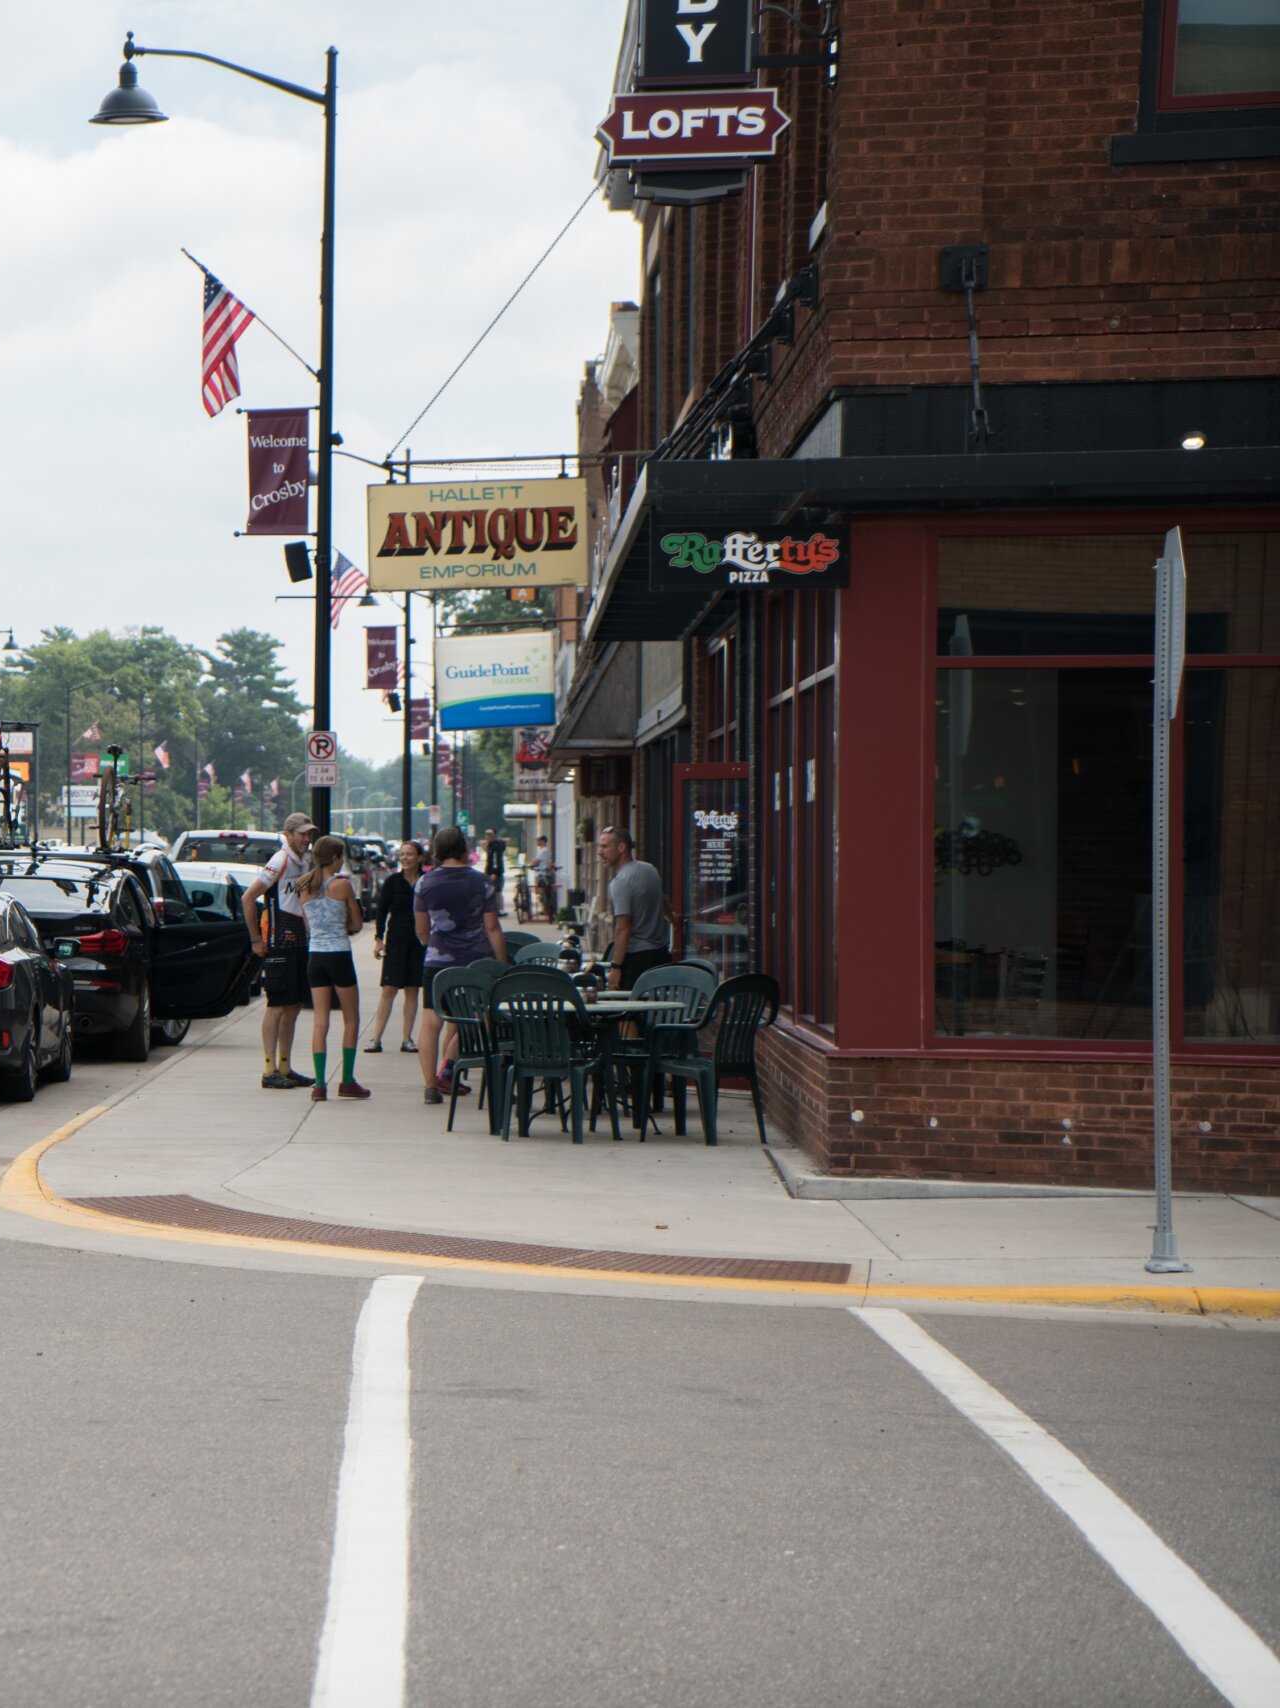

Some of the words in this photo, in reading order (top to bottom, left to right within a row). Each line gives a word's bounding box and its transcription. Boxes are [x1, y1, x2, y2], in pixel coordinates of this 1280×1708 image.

[622, 107, 766, 140] LOFTS
[250, 435, 308, 448] Welcome
[272, 462, 285, 474] to
[251, 479, 307, 511] Crosby
[429, 486, 524, 503] HALLETT
[376, 506, 579, 561] ANTIQUE
[660, 532, 840, 574] Rafferty's
[420, 563, 537, 579] EMPORIUM
[729, 572, 769, 583] PIZZA
[445, 663, 530, 679] GuidePoint
